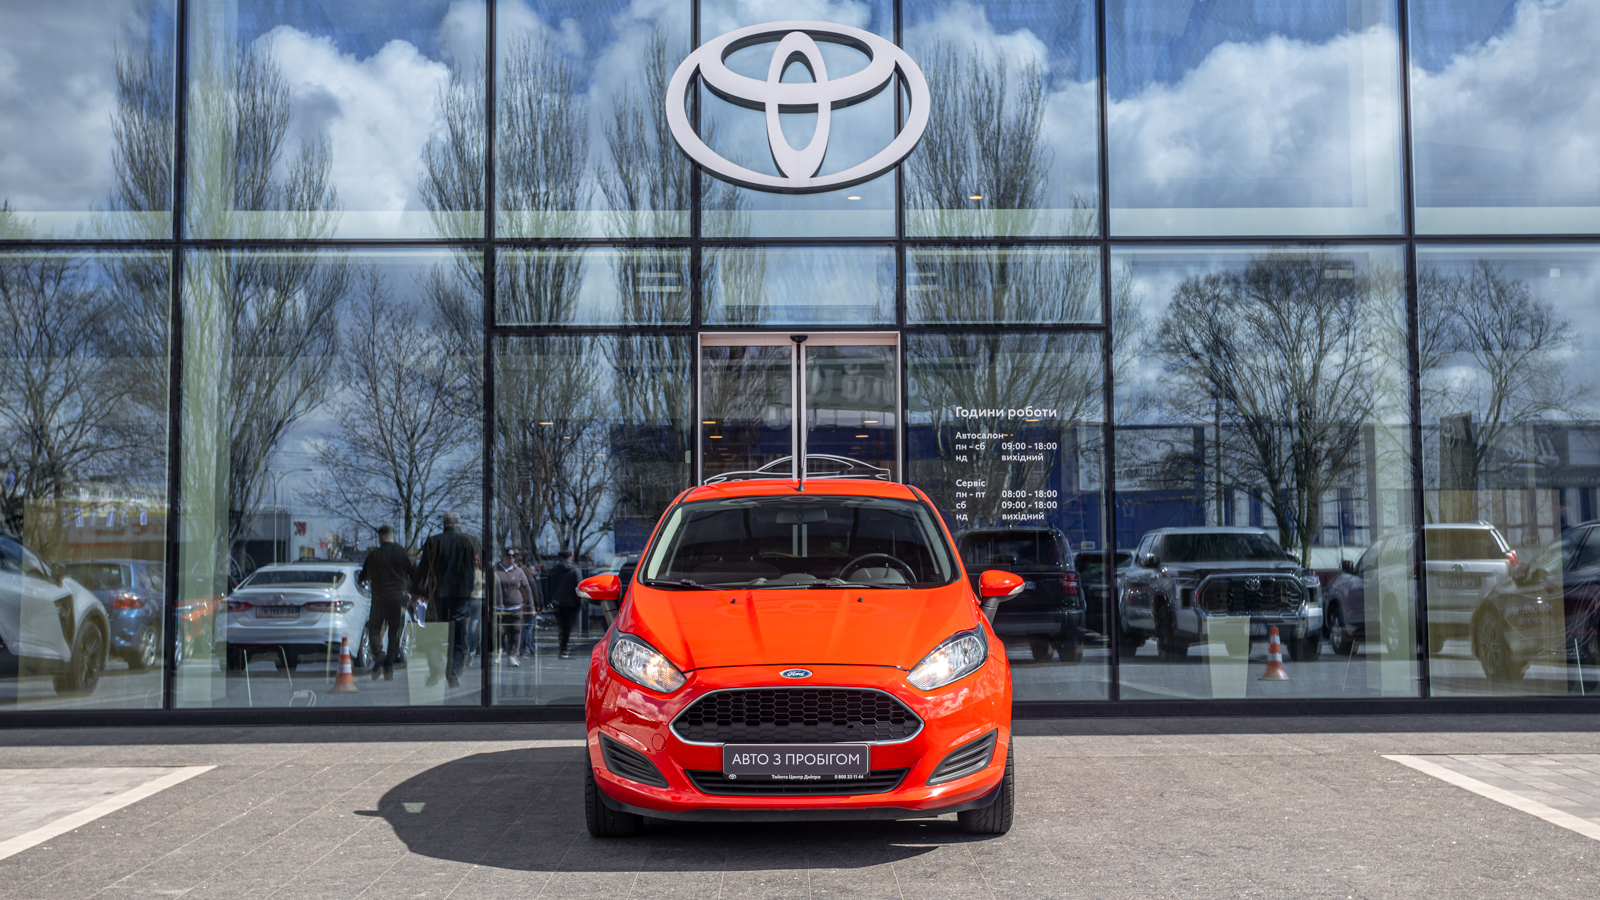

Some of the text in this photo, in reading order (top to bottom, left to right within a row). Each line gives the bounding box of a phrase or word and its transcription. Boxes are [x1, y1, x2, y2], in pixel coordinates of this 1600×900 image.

[955, 405, 1057, 420] Години роботи
[955, 431, 1004, 440] Автосалон
[975, 442, 986, 451] сб
[1001, 442, 1026, 451] 09:00
[1034, 442, 1058, 451] 18:00
[955, 453, 1044, 463] нд вихідний
[955, 479, 986, 489] Сервіс
[955, 491, 967, 499] пн
[975, 491, 986, 499] пт
[1001, 489, 1026, 499] 08:00
[1035, 489, 1058, 499] 18:00
[955, 500, 967, 510] сб
[1001, 500, 1026, 510] 09:00
[1034, 500, 1058, 510] 18:00
[955, 511, 1045, 522] нд вихідний
[731, 753, 860, 765] АВТО З ПРОБІГОМ
